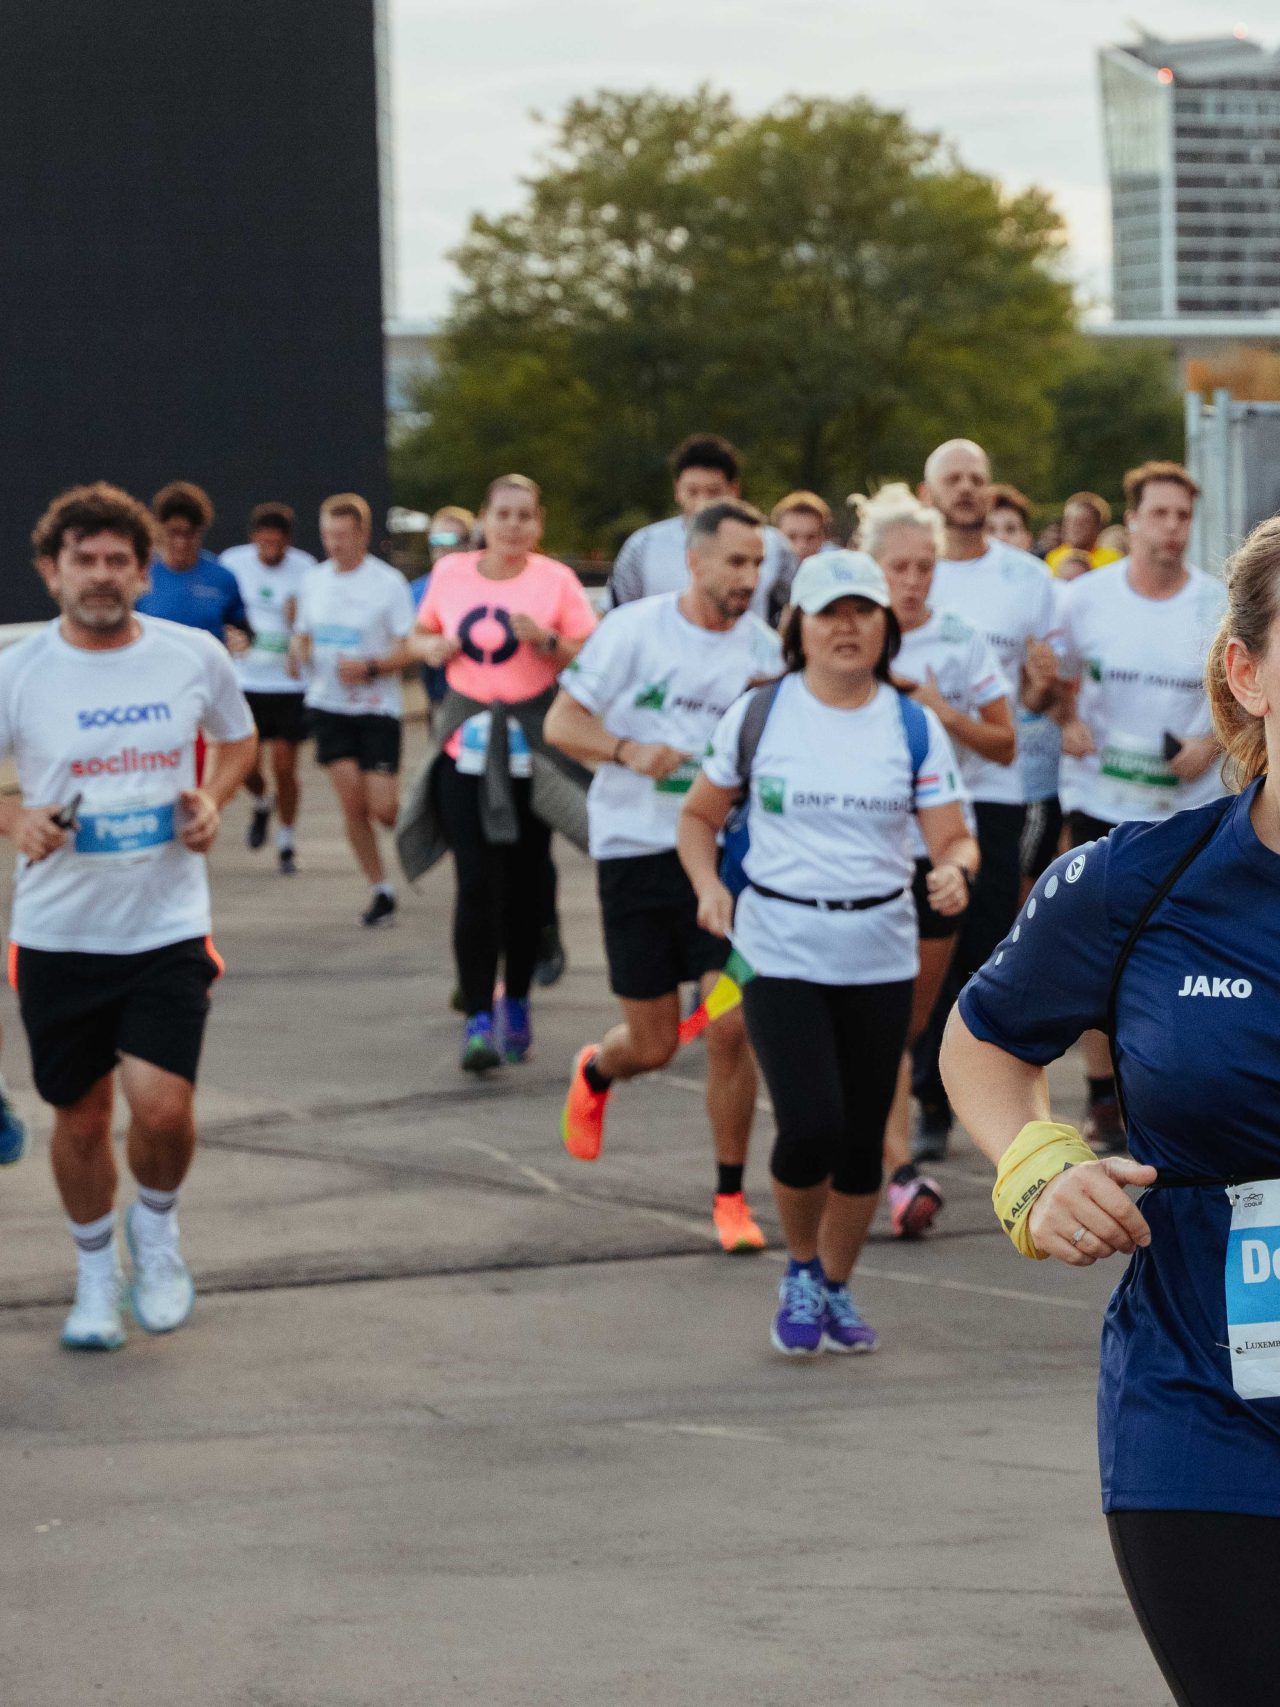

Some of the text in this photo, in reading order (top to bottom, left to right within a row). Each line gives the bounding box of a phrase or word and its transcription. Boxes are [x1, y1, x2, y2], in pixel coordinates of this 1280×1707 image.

[77, 702, 172, 729] socom
[793, 791, 911, 812] BNP PARIBA
[1178, 975, 1253, 999] JAKO
[1011, 1178, 1047, 1218] ALEBA
